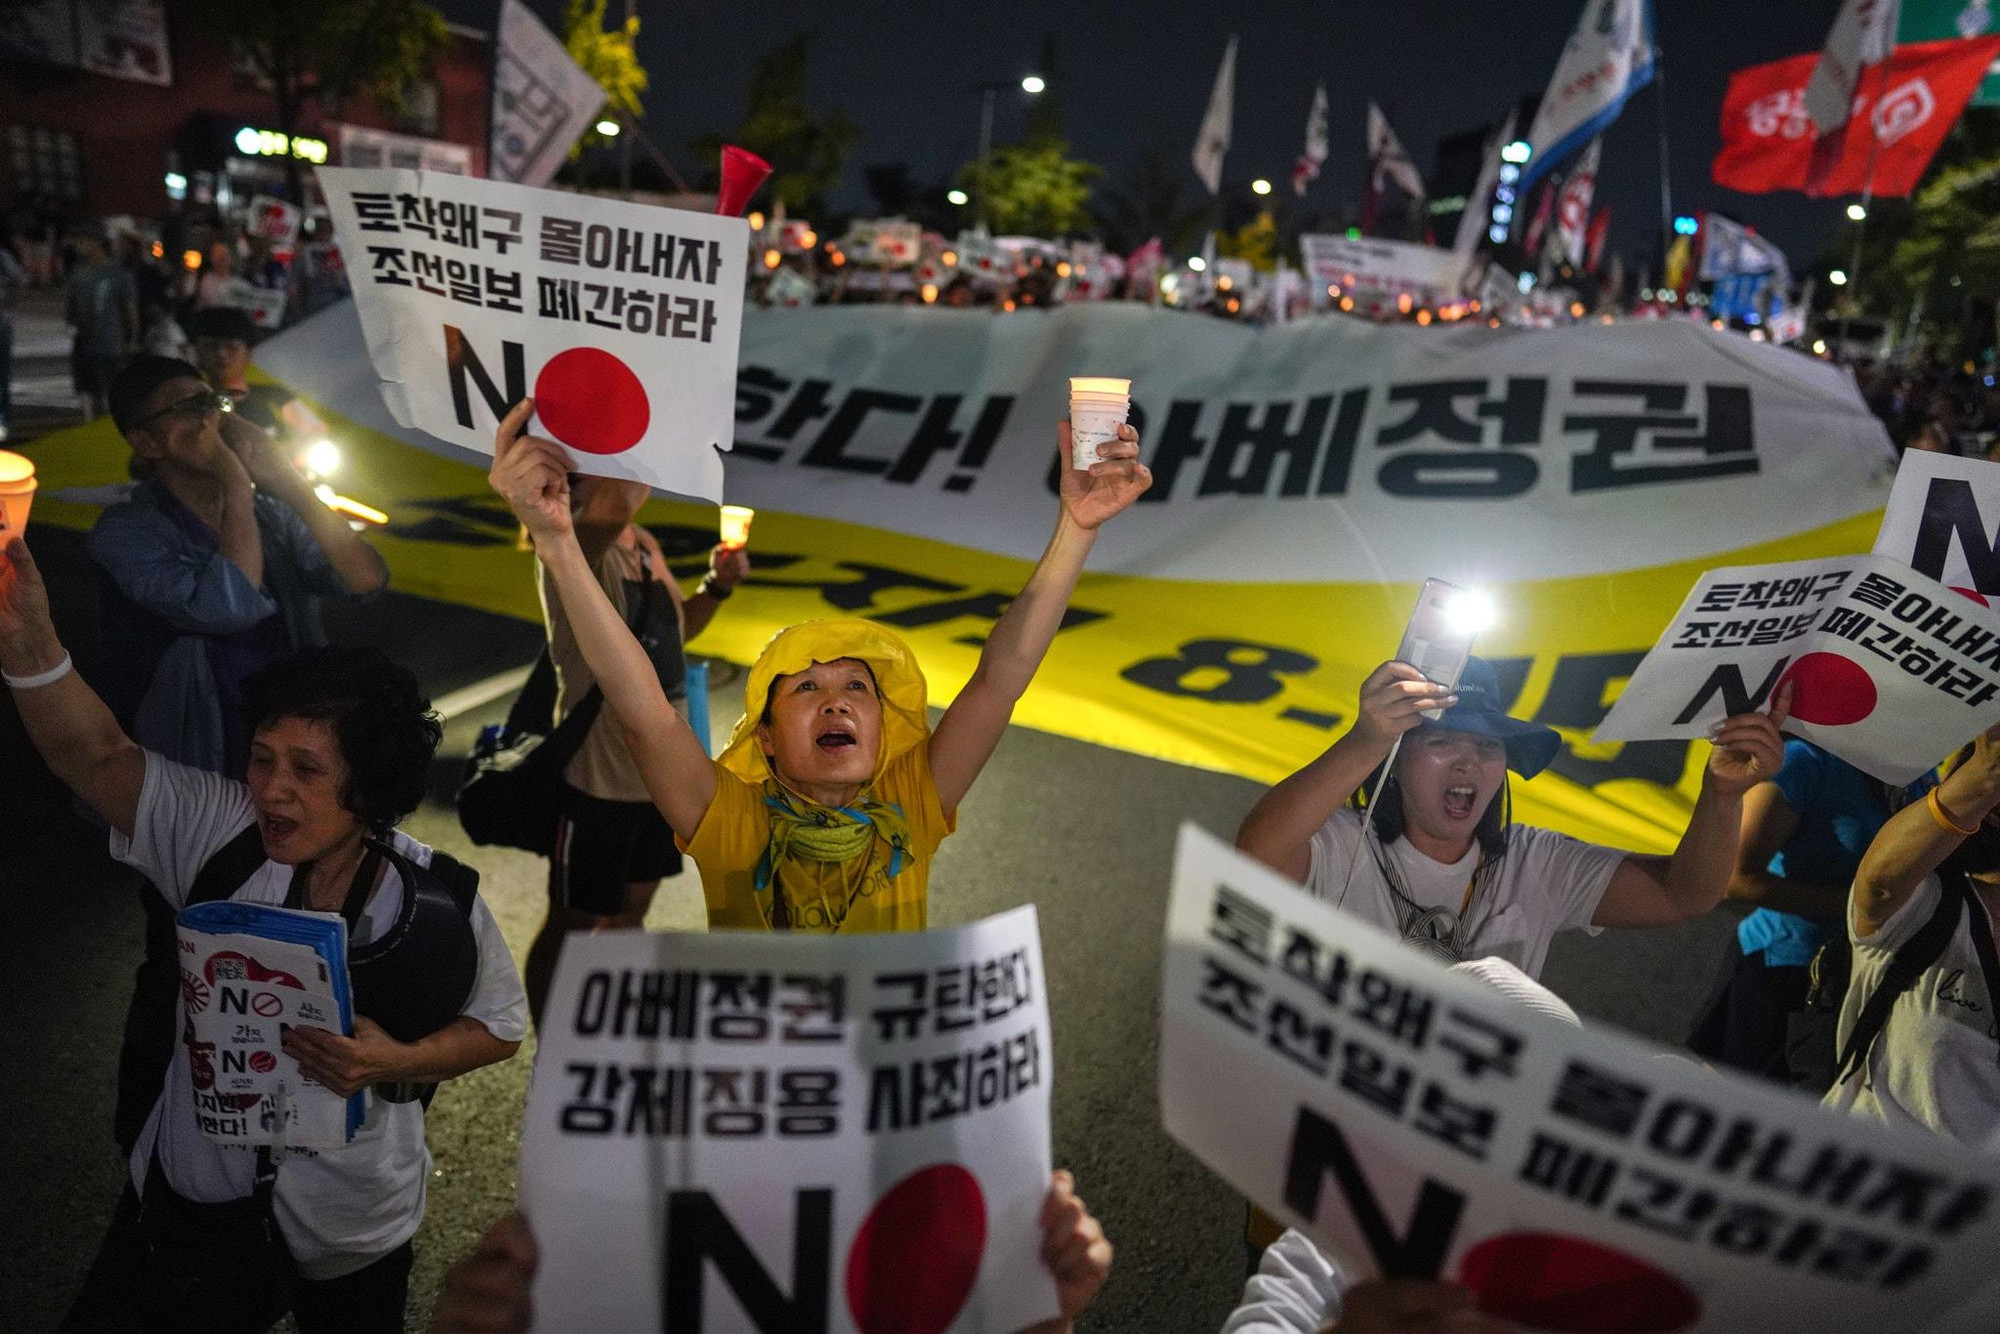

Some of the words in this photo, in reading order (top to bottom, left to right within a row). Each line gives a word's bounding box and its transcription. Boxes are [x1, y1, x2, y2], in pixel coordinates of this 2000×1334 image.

[350, 191, 523, 256] 토착왜구
[539, 215, 722, 286] 몰아내자
[366, 245, 524, 315] 조선일보
[536, 276, 718, 343] 폐간하라
[1047, 374, 1760, 504] 아베정권
[1695, 570, 1852, 612] 토착왜구
[1671, 607, 1822, 649] 조선일보
[1817, 605, 1999, 708] 폐간하라
[575, 970, 847, 1041] 아베정권
[872, 946, 1034, 1043] 규탄한다
[558, 1060, 841, 1139] 강제징용
[866, 1028, 1041, 1135] 사죄하라
[1199, 956, 1497, 1160] 조선일보
[1210, 882, 1529, 1079] 토착왜구
[1546, 1052, 1997, 1240] 몰아내자
